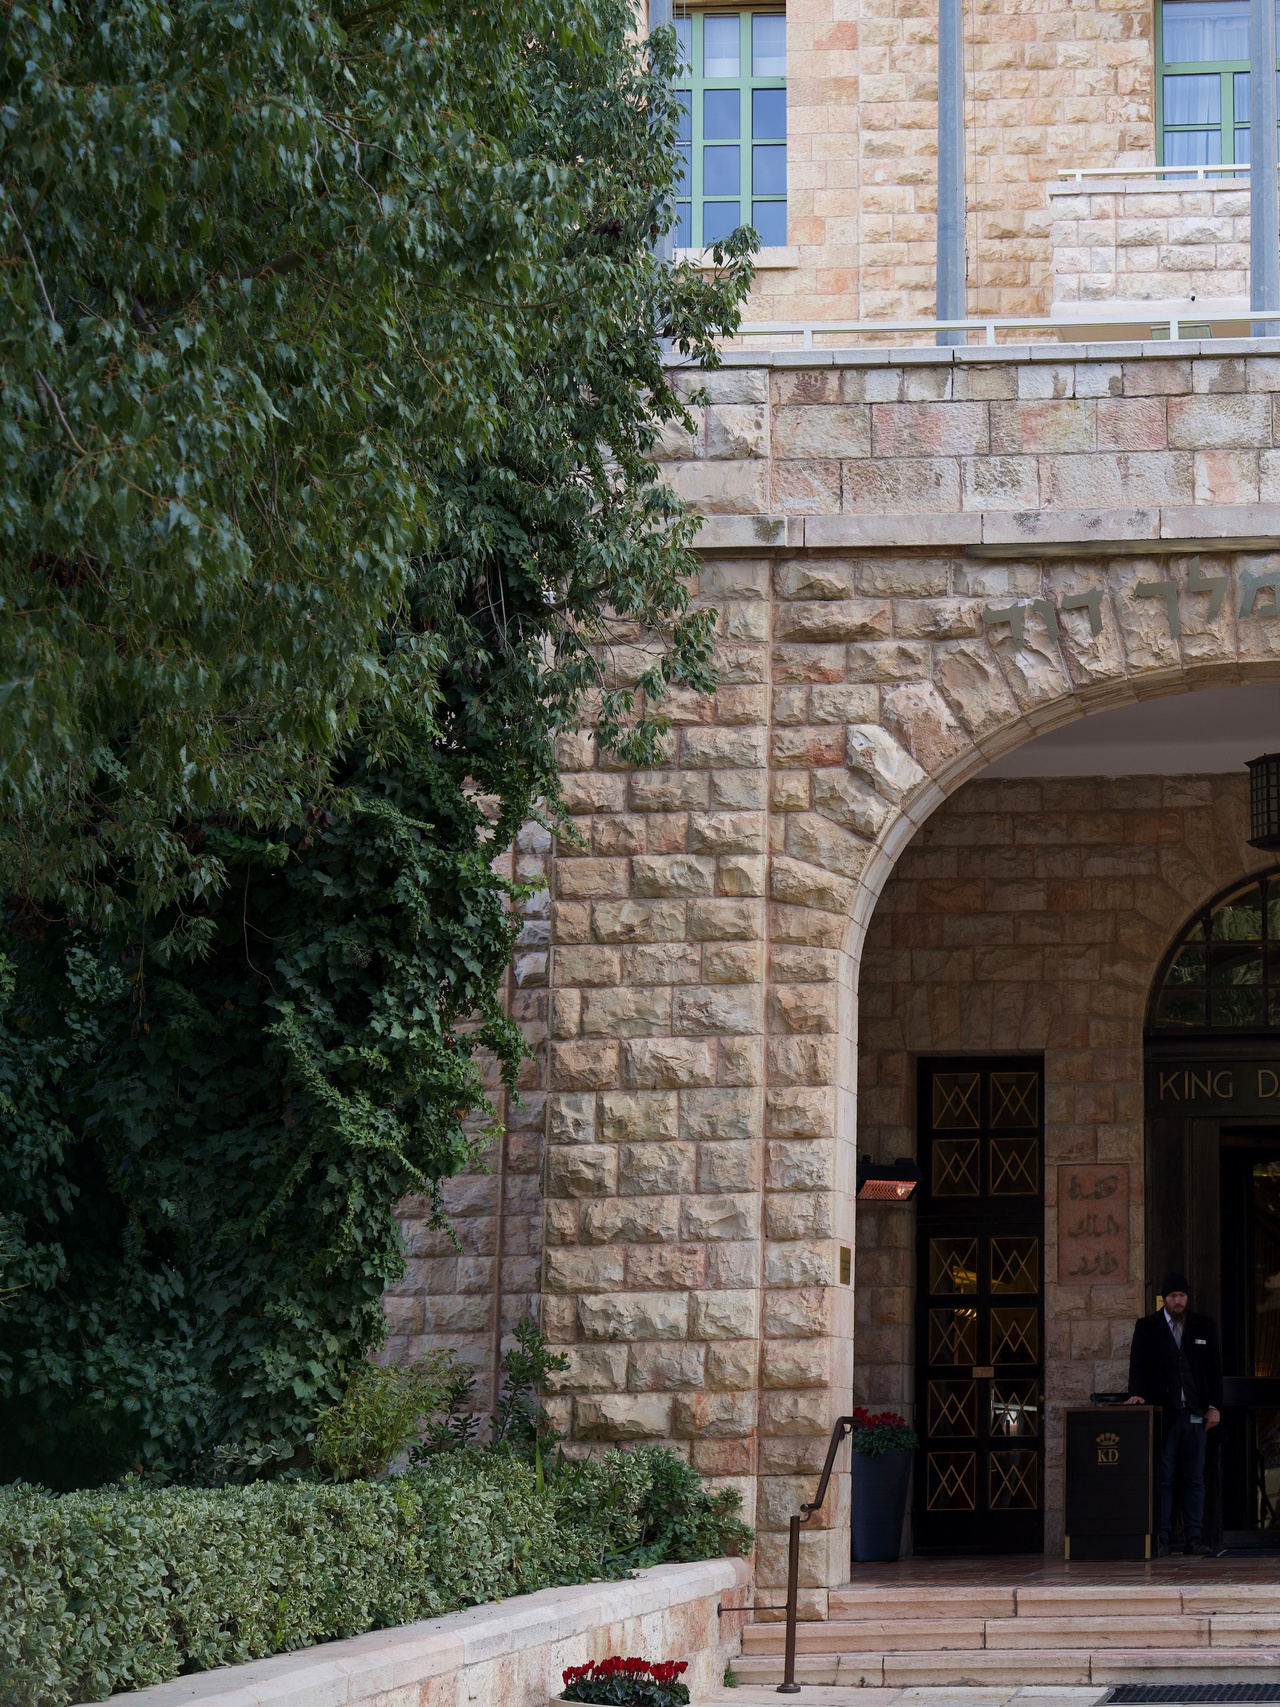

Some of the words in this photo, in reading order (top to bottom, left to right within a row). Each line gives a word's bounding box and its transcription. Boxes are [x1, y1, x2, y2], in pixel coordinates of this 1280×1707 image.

[983, 586, 1105, 650] דוד
[1158, 1070, 1234, 1100] KING
[1097, 1449, 1119, 1463] KD
